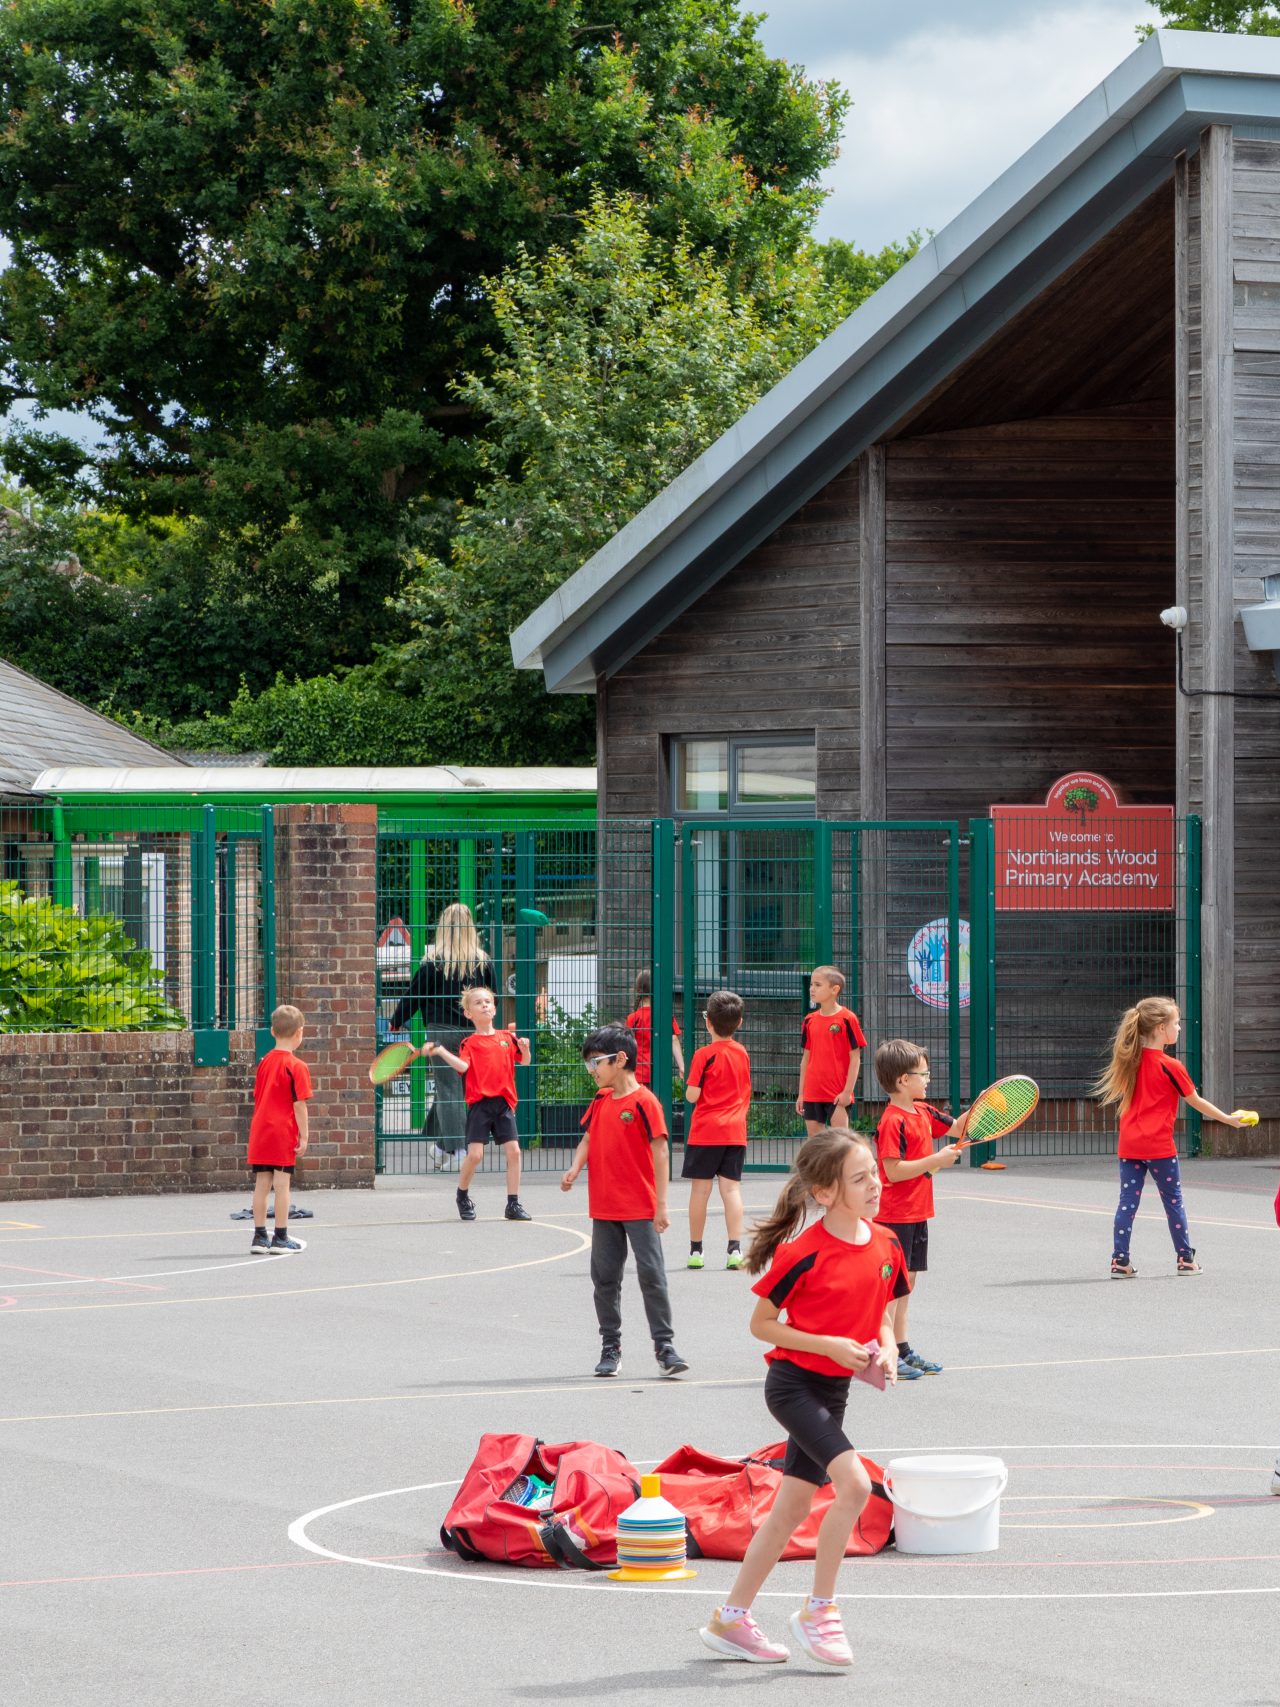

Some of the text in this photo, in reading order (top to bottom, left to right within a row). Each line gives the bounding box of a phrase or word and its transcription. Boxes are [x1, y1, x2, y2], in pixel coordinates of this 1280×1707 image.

[1049, 831, 1101, 843] Wecome
[1007, 848, 1157, 865] Northlands Wood
[1006, 869, 1160, 890] Primary Academy
